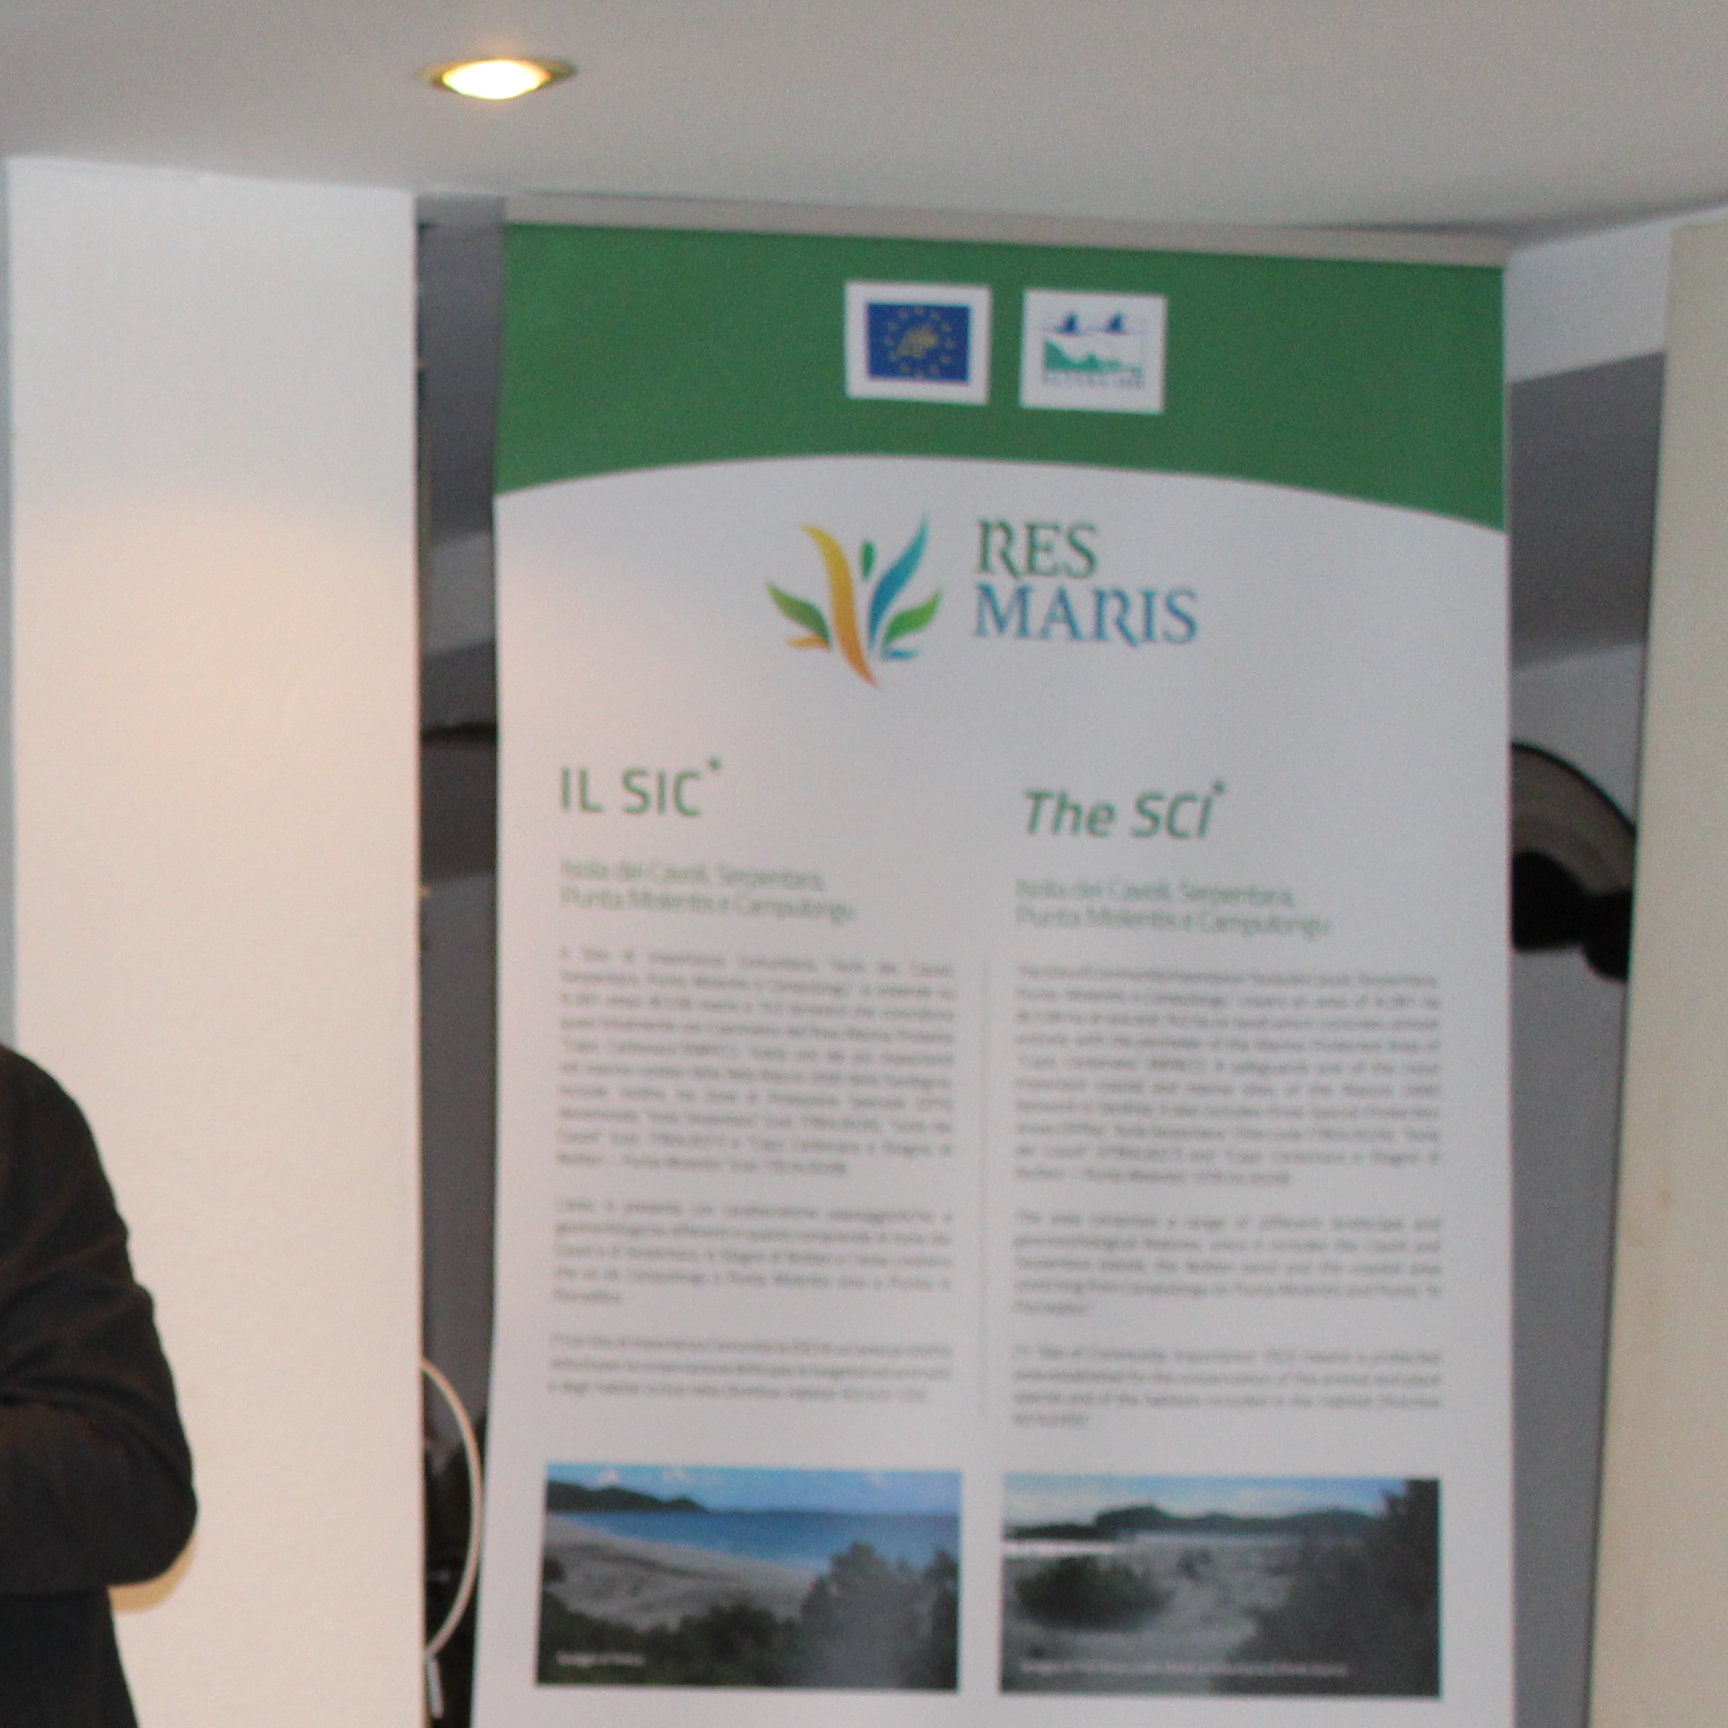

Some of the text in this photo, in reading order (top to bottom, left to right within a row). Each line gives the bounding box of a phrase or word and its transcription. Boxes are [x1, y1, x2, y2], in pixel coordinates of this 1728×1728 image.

[977, 518, 1099, 580] RES
[974, 582, 1199, 648] MARIS
[560, 766, 606, 813] IL
[1024, 788, 1117, 837] The
